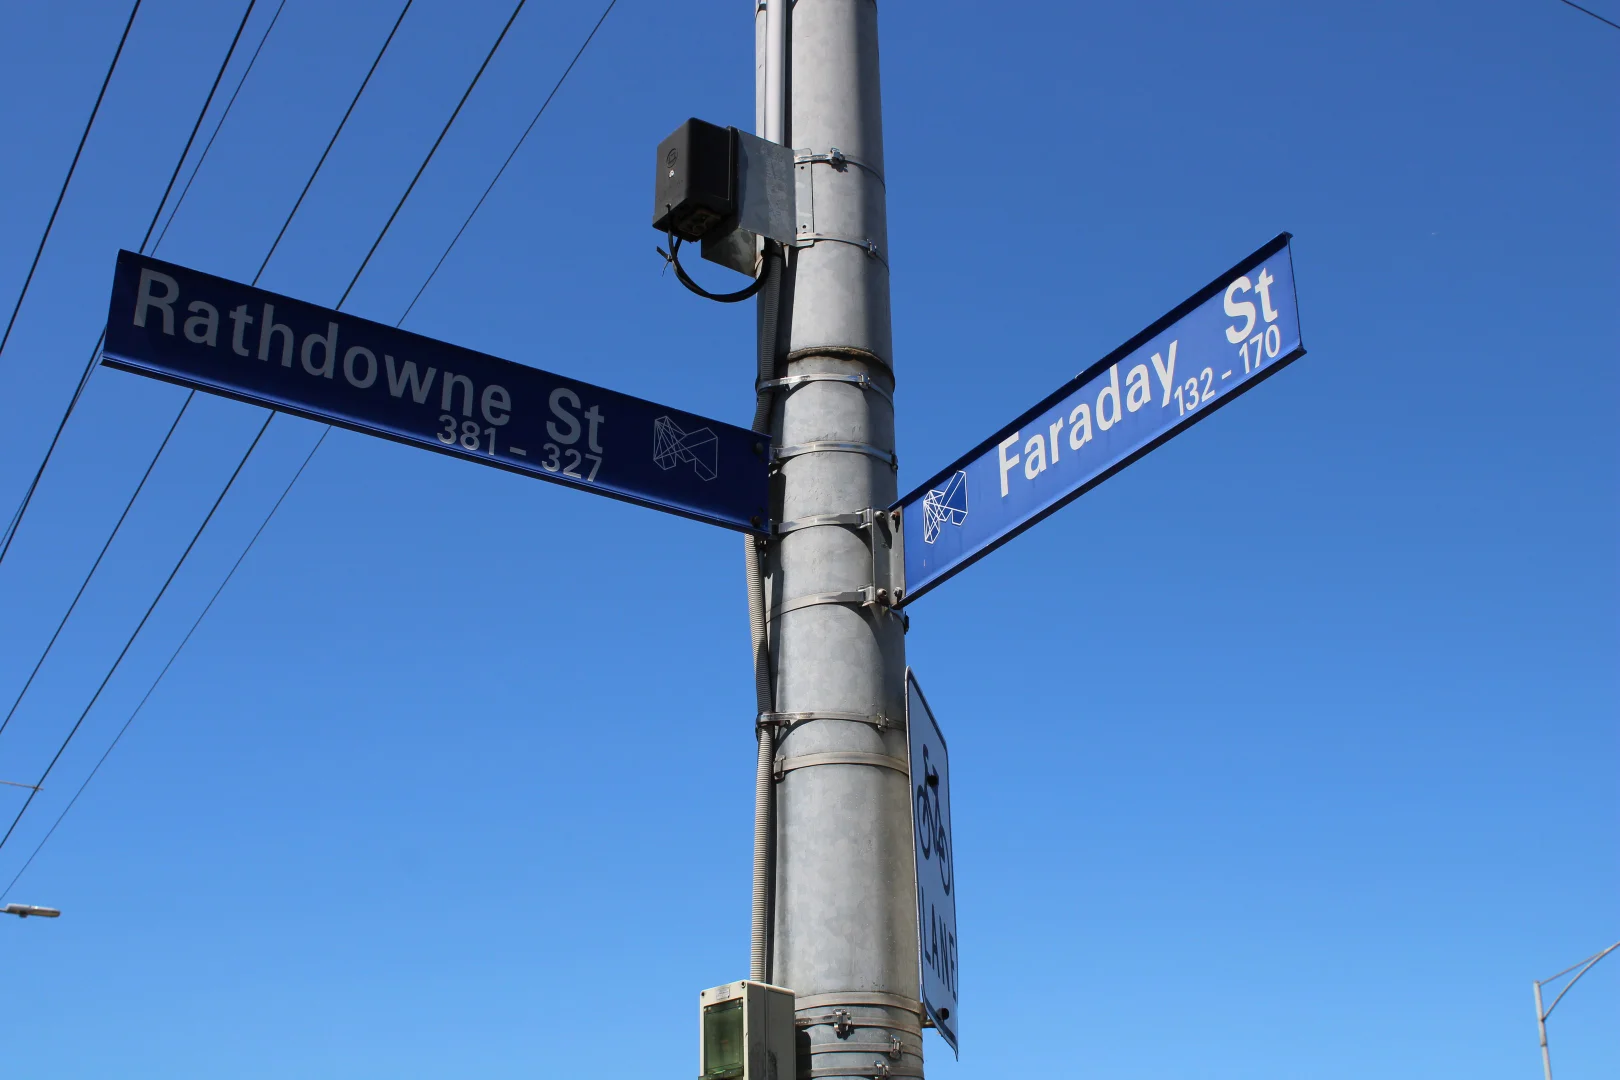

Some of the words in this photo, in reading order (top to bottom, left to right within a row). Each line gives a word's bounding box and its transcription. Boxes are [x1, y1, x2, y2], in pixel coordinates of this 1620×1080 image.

[132, 266, 512, 426] Rathdowne
[545, 387, 605, 454] St
[998, 339, 1178, 498] Faraday
[1223, 267, 1279, 345] St
[1173, 366, 1216, 417] 132
[1238, 324, 1281, 375] 170
[436, 413, 496, 456] 381
[540, 442, 603, 483] 327
[921, 885, 957, 1002] LANE
